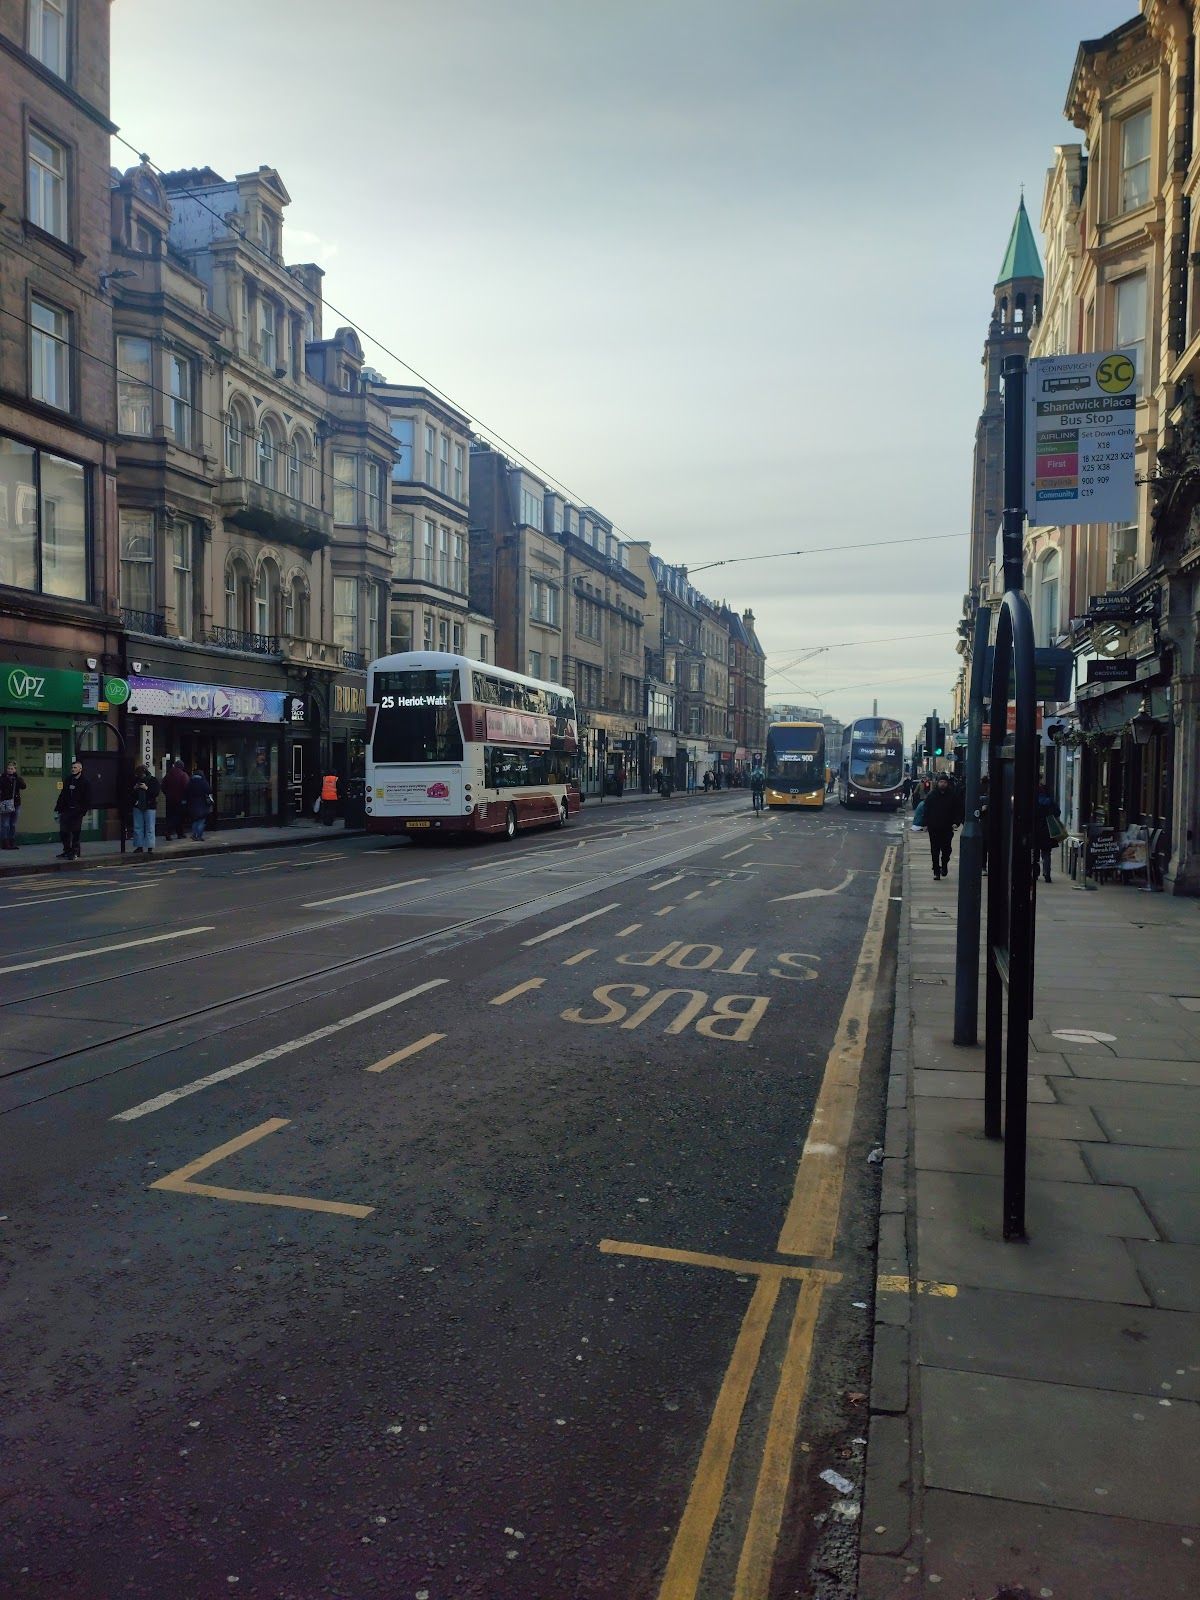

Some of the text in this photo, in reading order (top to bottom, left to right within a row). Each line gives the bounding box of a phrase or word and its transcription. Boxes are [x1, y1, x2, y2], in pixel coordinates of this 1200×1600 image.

[1099, 362, 1131, 383] SC
[1043, 398, 1131, 413] Shandwick Place
[1061, 413, 1114, 426] Bus Stop
[1040, 432, 1076, 441] AIRLINK
[1082, 428, 1135, 439] Set Down Only
[1091, 454, 1104, 462] X22
[1105, 453, 1119, 461] X23
[1120, 452, 1134, 460] X24
[1047, 460, 1067, 469] First
[1082, 463, 1111, 472] X25 X38
[1081, 476, 1110, 485] 900 909
[1039, 490, 1075, 499] Community
[1081, 489, 1094, 497] C19
[1097, 596, 1130, 604] BELHAVEN
[13, 675, 46, 698] VPZ
[108, 685, 125, 696] VPZ
[169, 689, 209, 710] TACO
[232, 695, 264, 715] BELL
[381, 694, 448, 709] 25 Heriot-Watt
[801, 754, 814, 762] 900
[615, 941, 822, 980] STOP
[559, 983, 772, 1042] BUS
